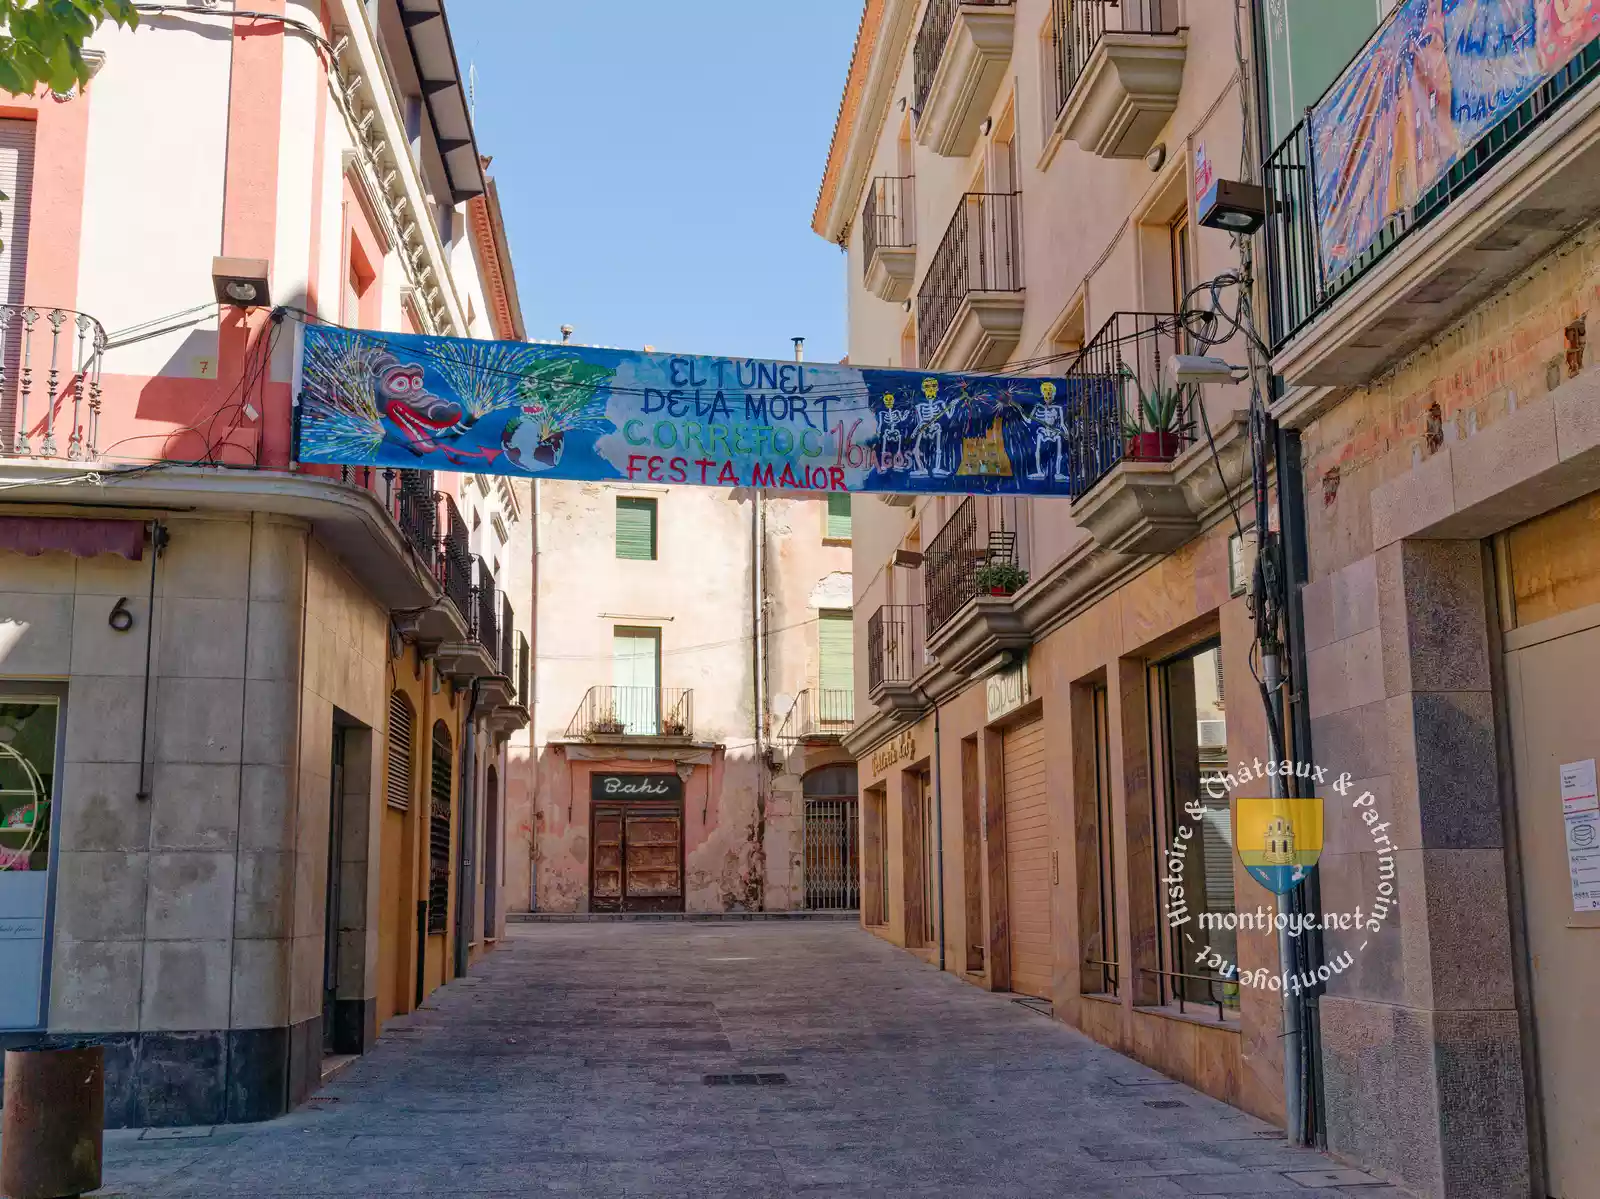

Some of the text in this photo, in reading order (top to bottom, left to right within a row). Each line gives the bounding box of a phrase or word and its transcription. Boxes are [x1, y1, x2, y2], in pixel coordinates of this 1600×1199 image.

[200, 361, 208, 374] 7
[670, 358, 814, 394] EL TÚNEL
[641, 388, 690, 417] DE
[745, 393, 841, 432] MORT
[622, 418, 824, 458] CORREFOC
[830, 418, 863, 468] 16
[626, 454, 848, 492] FESTA MAJOR
[109, 597, 133, 632] 6
